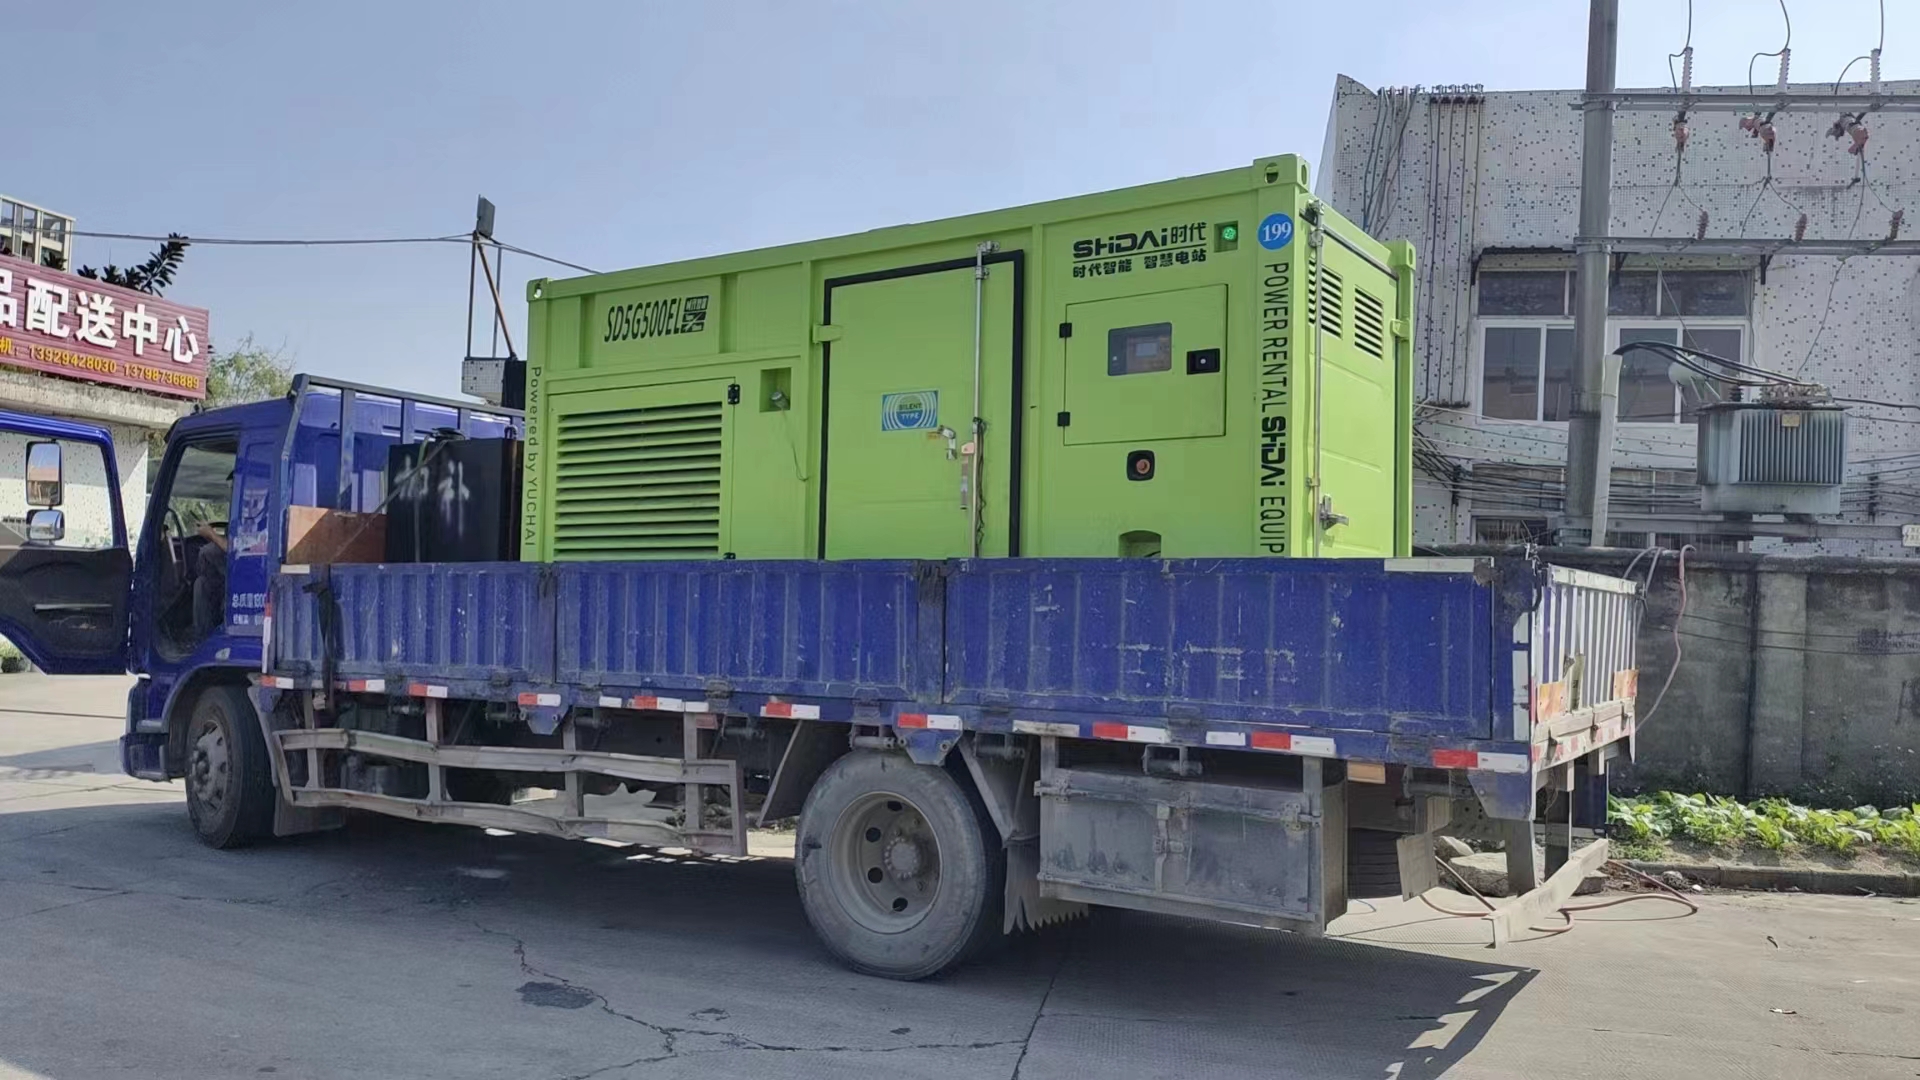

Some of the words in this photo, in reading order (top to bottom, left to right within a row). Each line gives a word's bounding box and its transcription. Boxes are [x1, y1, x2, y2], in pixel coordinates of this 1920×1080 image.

[1171, 222, 1207, 244] 时代
[1263, 221, 1292, 242] 199
[1073, 259, 1132, 278] 时代智能
[1144, 248, 1207, 269] 智慧电站
[1263, 262, 1289, 331] POWER
[29, 344, 117, 373] 13929428030
[123, 363, 200, 389] 13798736889
[1261, 337, 1288, 413] RENTAL
[528, 366, 541, 446] Powered
[901, 412, 920, 420] TYPE
[525, 452, 539, 472] by
[524, 477, 538, 546] YUCHAI
[1260, 496, 1285, 553] EQUIP
